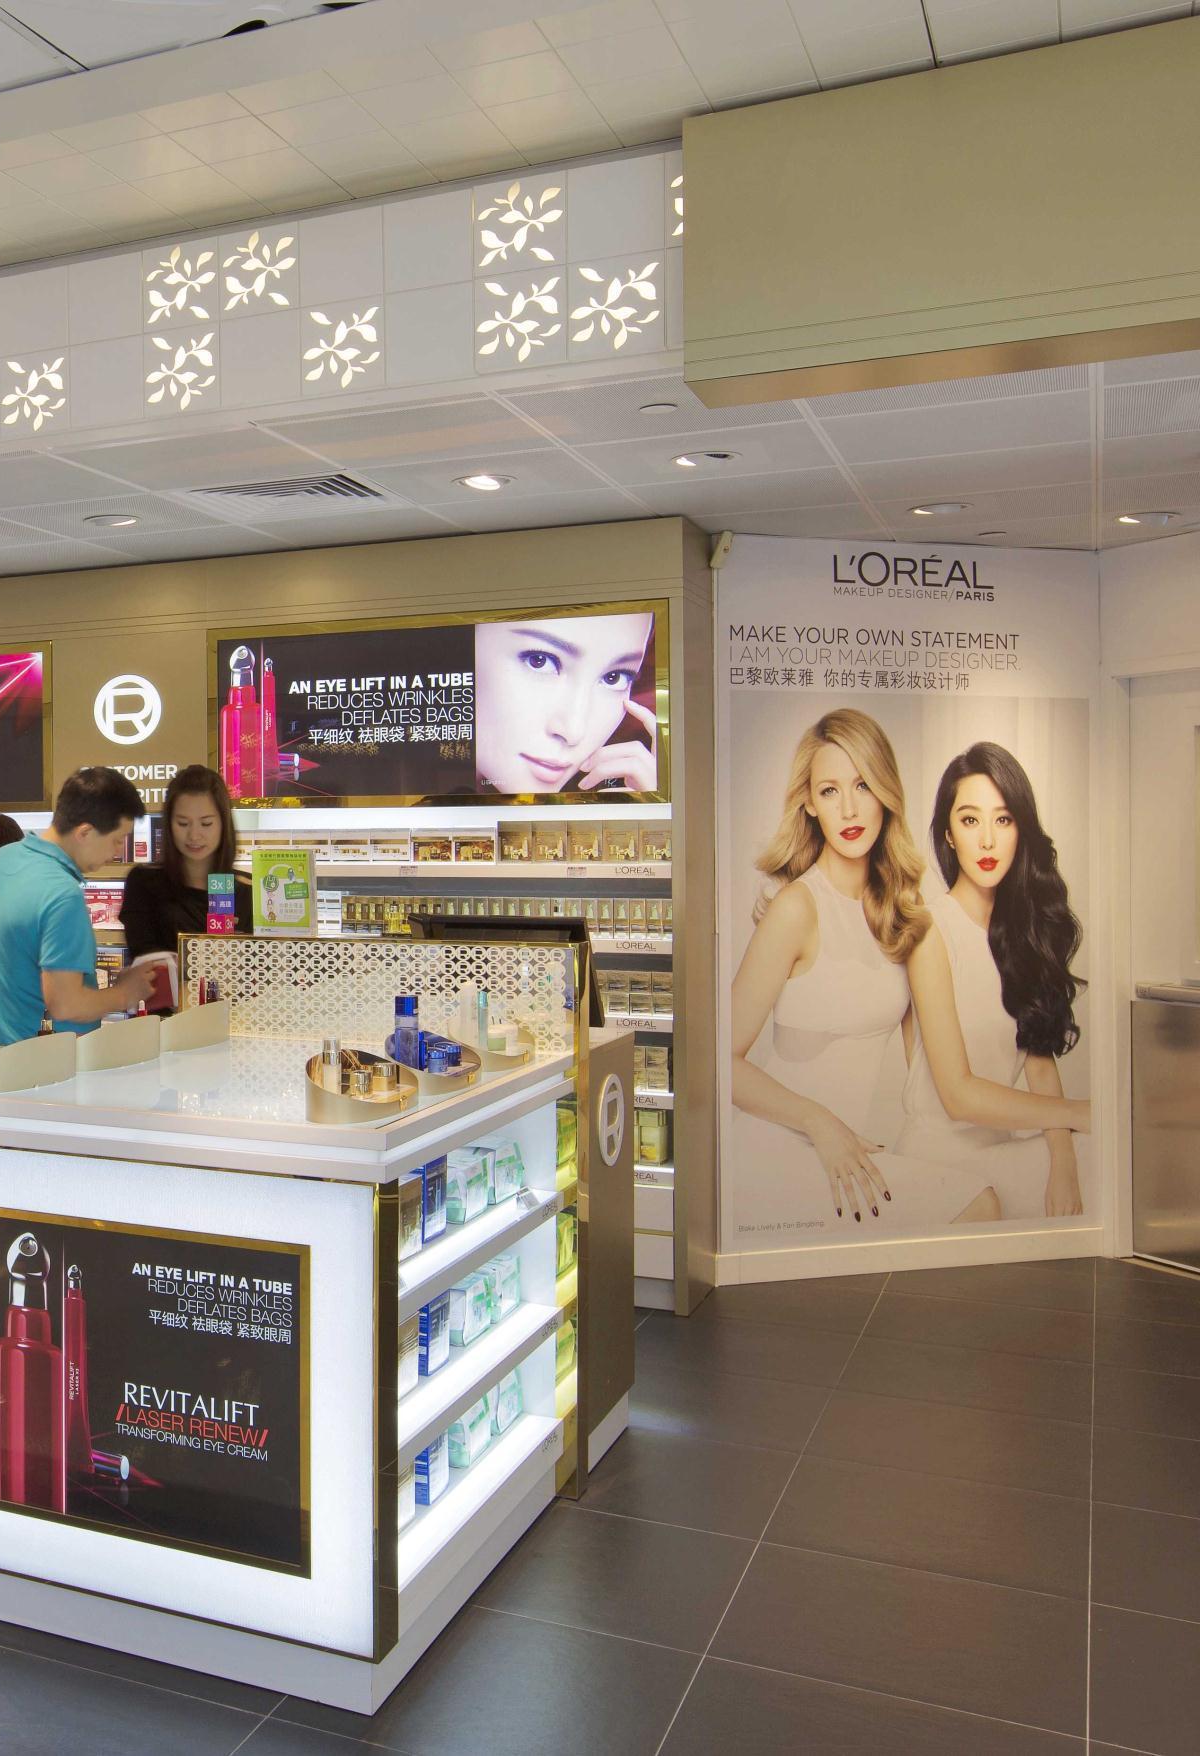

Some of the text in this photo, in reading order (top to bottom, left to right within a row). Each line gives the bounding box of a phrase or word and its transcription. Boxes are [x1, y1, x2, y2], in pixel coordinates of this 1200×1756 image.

[833, 552, 994, 589] L'ORÉAL
[834, 587, 883, 598] MAKEUP
[730, 625, 1020, 650] MAKE YOUR OWN STATEMENT
[740, 647, 770, 663] AM
[776, 648, 832, 665] YOUR
[838, 649, 919, 667] MAKEUP
[289, 672, 473, 694] AN EYE LIFT IN A TUBE
[729, 668, 970, 690] 巴黎欧莱雅 你的专属彩妆设计师
[308, 688, 473, 710] REDUCES WRINKLES
[342, 706, 473, 726] DEFLATES BAGS
[308, 724, 473, 746] 平细纹 祛眼袋 紧致眼周
[211, 880, 223, 889] 3x
[210, 919, 222, 929] 3x
[738, 1224, 754, 1232] Blake
[757, 1224, 775, 1232] Lively
[132, 1263, 292, 1295] AN EYE LIFT IN A TUBE
[148, 1279, 292, 1311] REDUCES WRINKLES
[178, 1298, 292, 1327] DEFLATES BAGS
[149, 1310, 291, 1344] 平细纹 祛眼袋 紧致眼周
[124, 1382, 259, 1426] REVITALIFT
[116, 1423, 268, 1462] TRANSFORMING EYE CREAM
